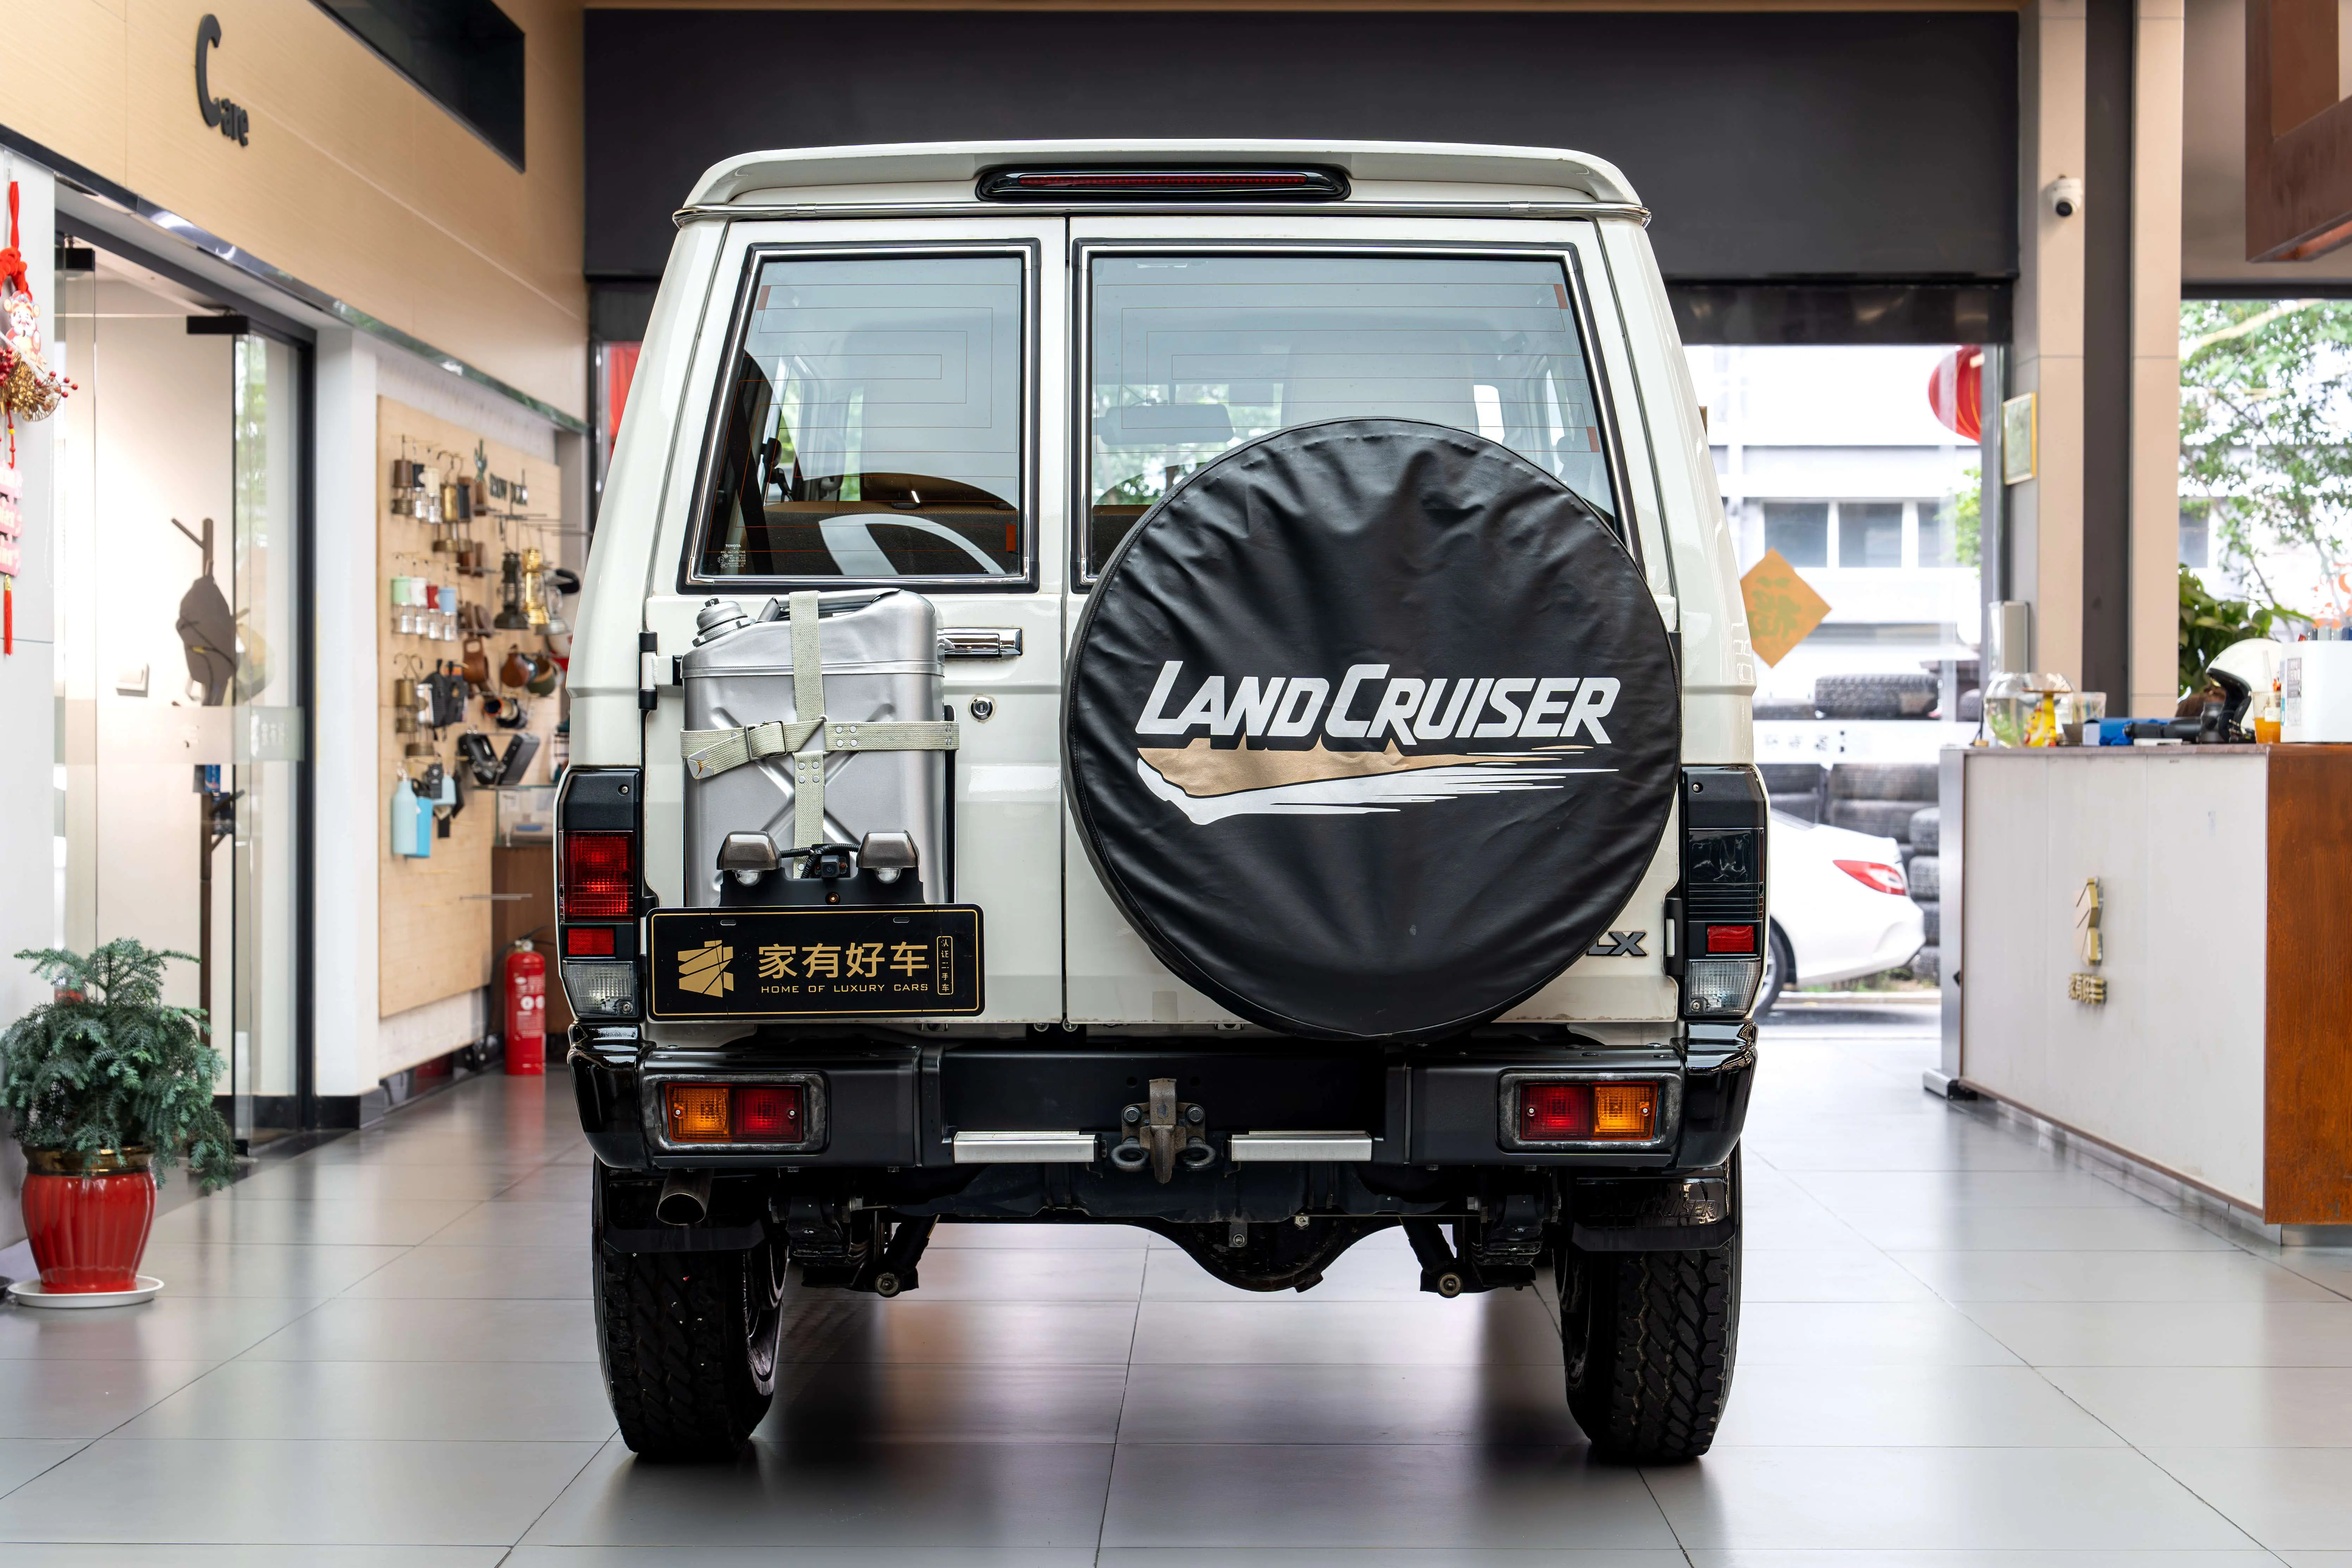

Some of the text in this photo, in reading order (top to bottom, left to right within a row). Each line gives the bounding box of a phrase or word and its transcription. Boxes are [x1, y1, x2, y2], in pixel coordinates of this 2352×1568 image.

[196, 13, 249, 147] Care
[758, 941, 928, 979] 家有好车
[941, 939, 949, 992] 认证二手车
[834, 984, 885, 992] LUXURY
